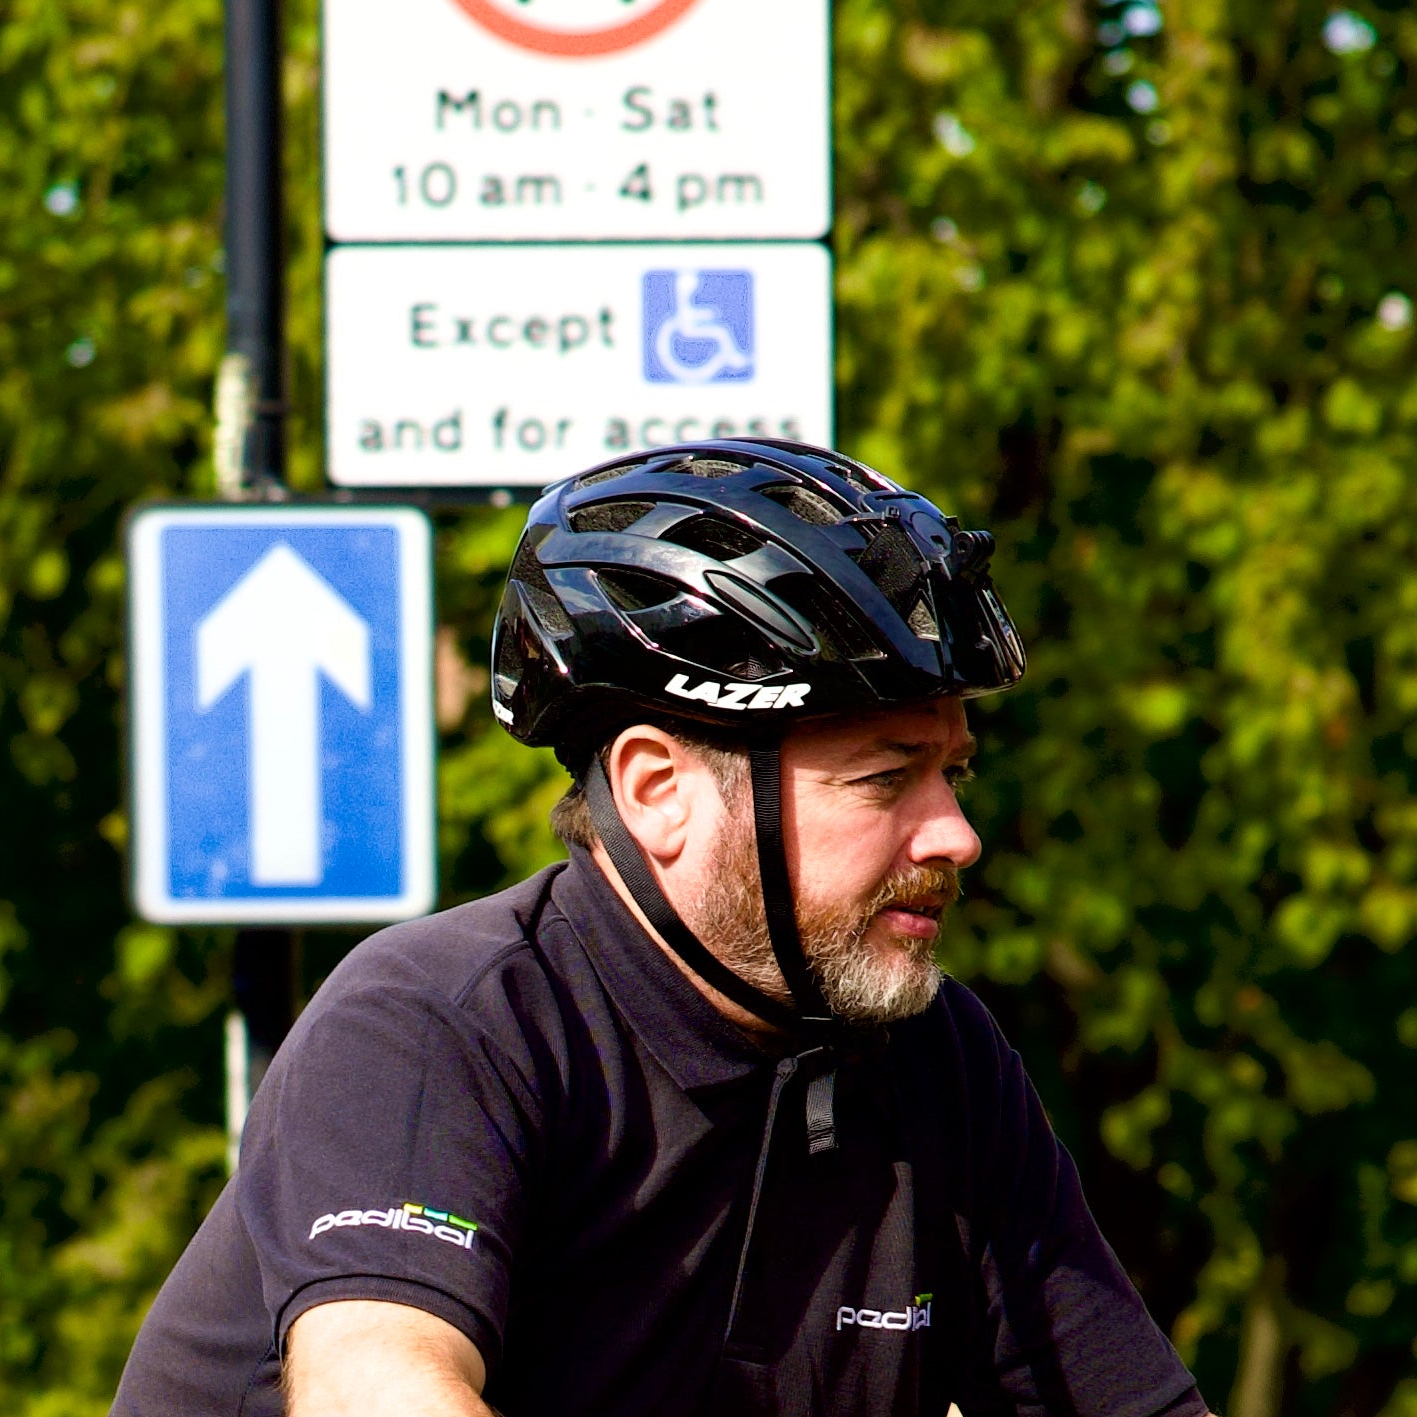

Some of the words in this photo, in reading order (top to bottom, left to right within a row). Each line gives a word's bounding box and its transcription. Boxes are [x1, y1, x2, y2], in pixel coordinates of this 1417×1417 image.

[435, 89, 562, 132] Mon
[620, 86, 720, 132] Sat
[394, 162, 458, 207] 10
[479, 171, 562, 205] am
[617, 162, 652, 202] 4
[676, 171, 765, 213] pm
[409, 302, 616, 353] Except
[357, 408, 463, 452] and
[492, 407, 572, 452] for
[664, 672, 812, 711] LAZER
